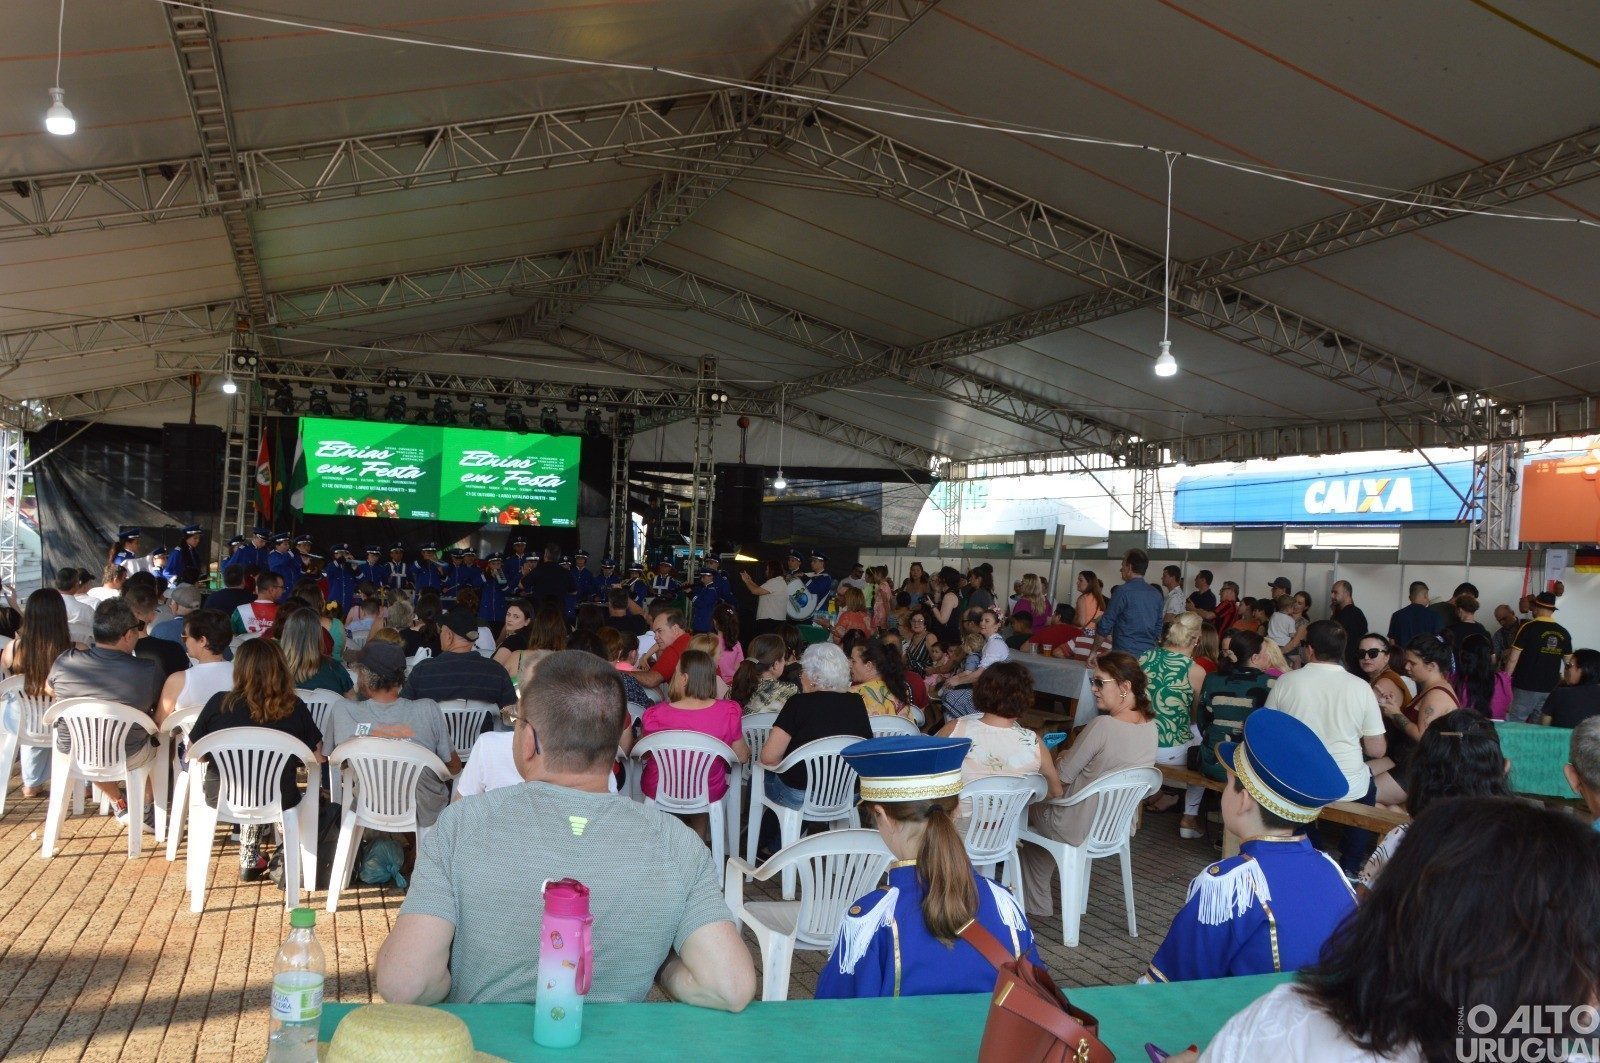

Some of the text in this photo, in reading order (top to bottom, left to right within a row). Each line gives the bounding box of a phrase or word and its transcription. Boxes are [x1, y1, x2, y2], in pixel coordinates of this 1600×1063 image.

[315, 441, 395, 459] Etnias
[459, 451, 535, 468] Etnias
[317, 461, 426, 478] em Festa
[460, 470, 566, 487] em Festa
[1304, 477, 1413, 514] CAIXA
